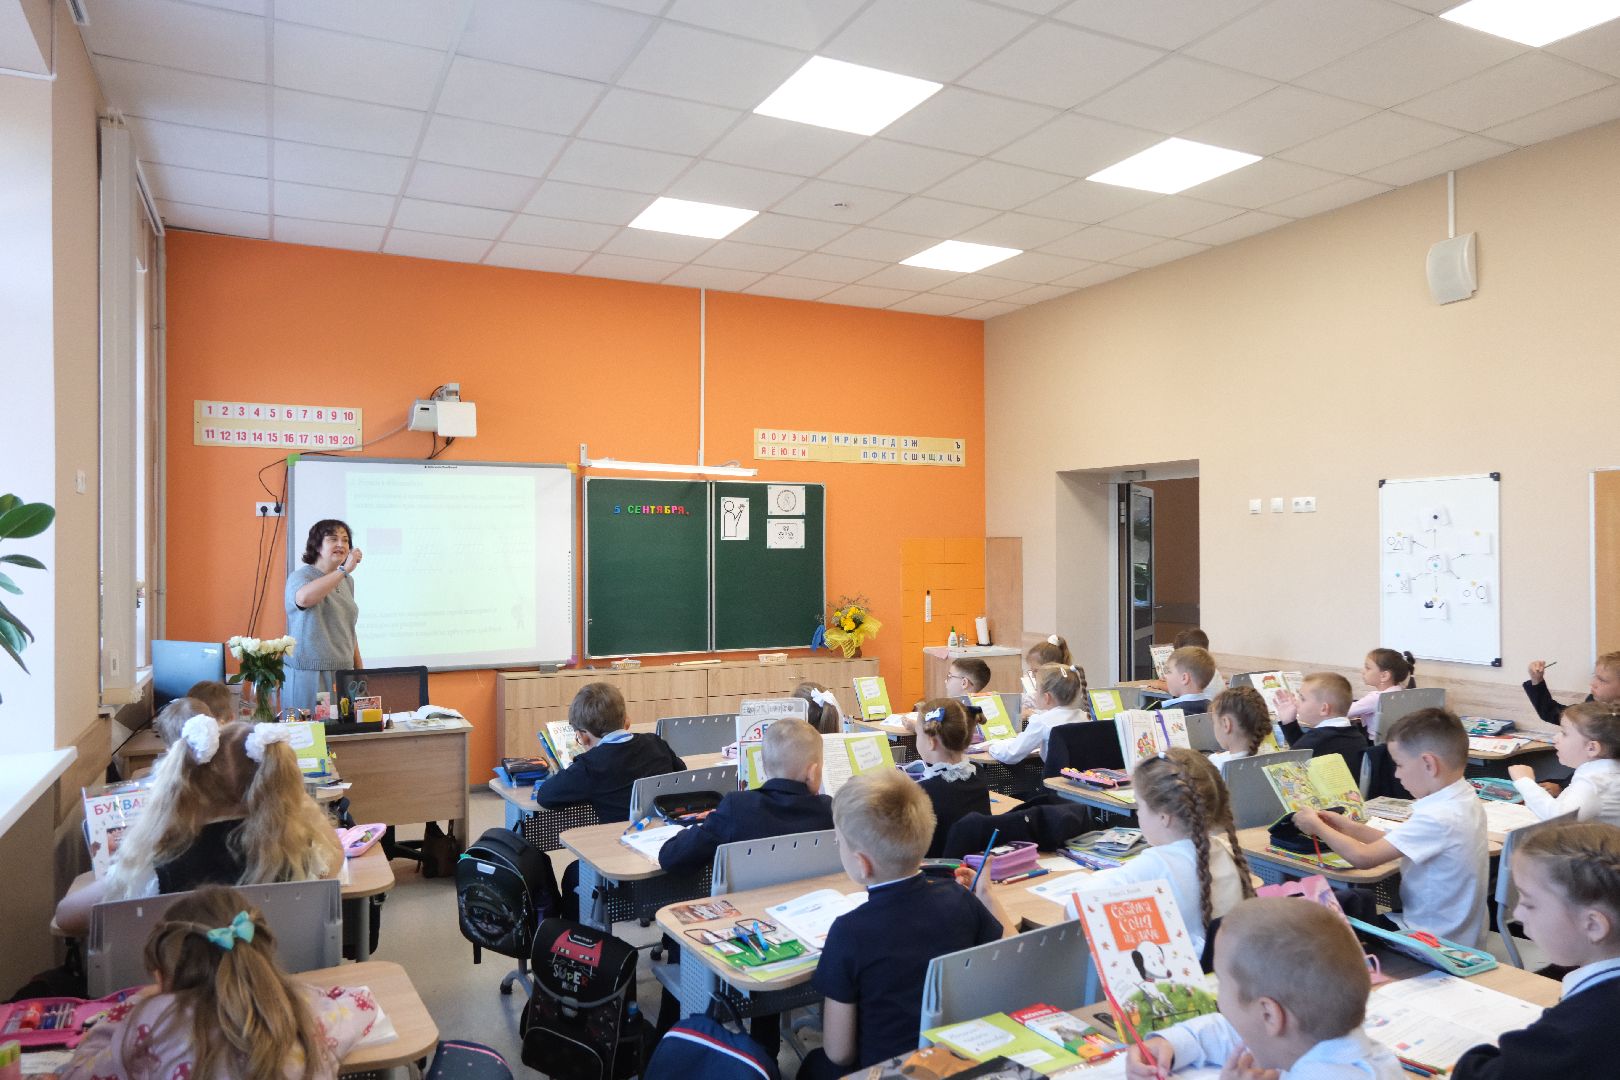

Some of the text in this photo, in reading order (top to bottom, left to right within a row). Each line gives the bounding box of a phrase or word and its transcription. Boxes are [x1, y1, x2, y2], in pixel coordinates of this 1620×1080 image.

[208, 406, 353, 420] 1 2 3 4 5 6 7 8 9 10
[205, 429, 354, 444] 11 12 13 14 15 16 17 18 19 20
[614, 506, 621, 514] 5
[553, 964, 589, 989] SUPER
